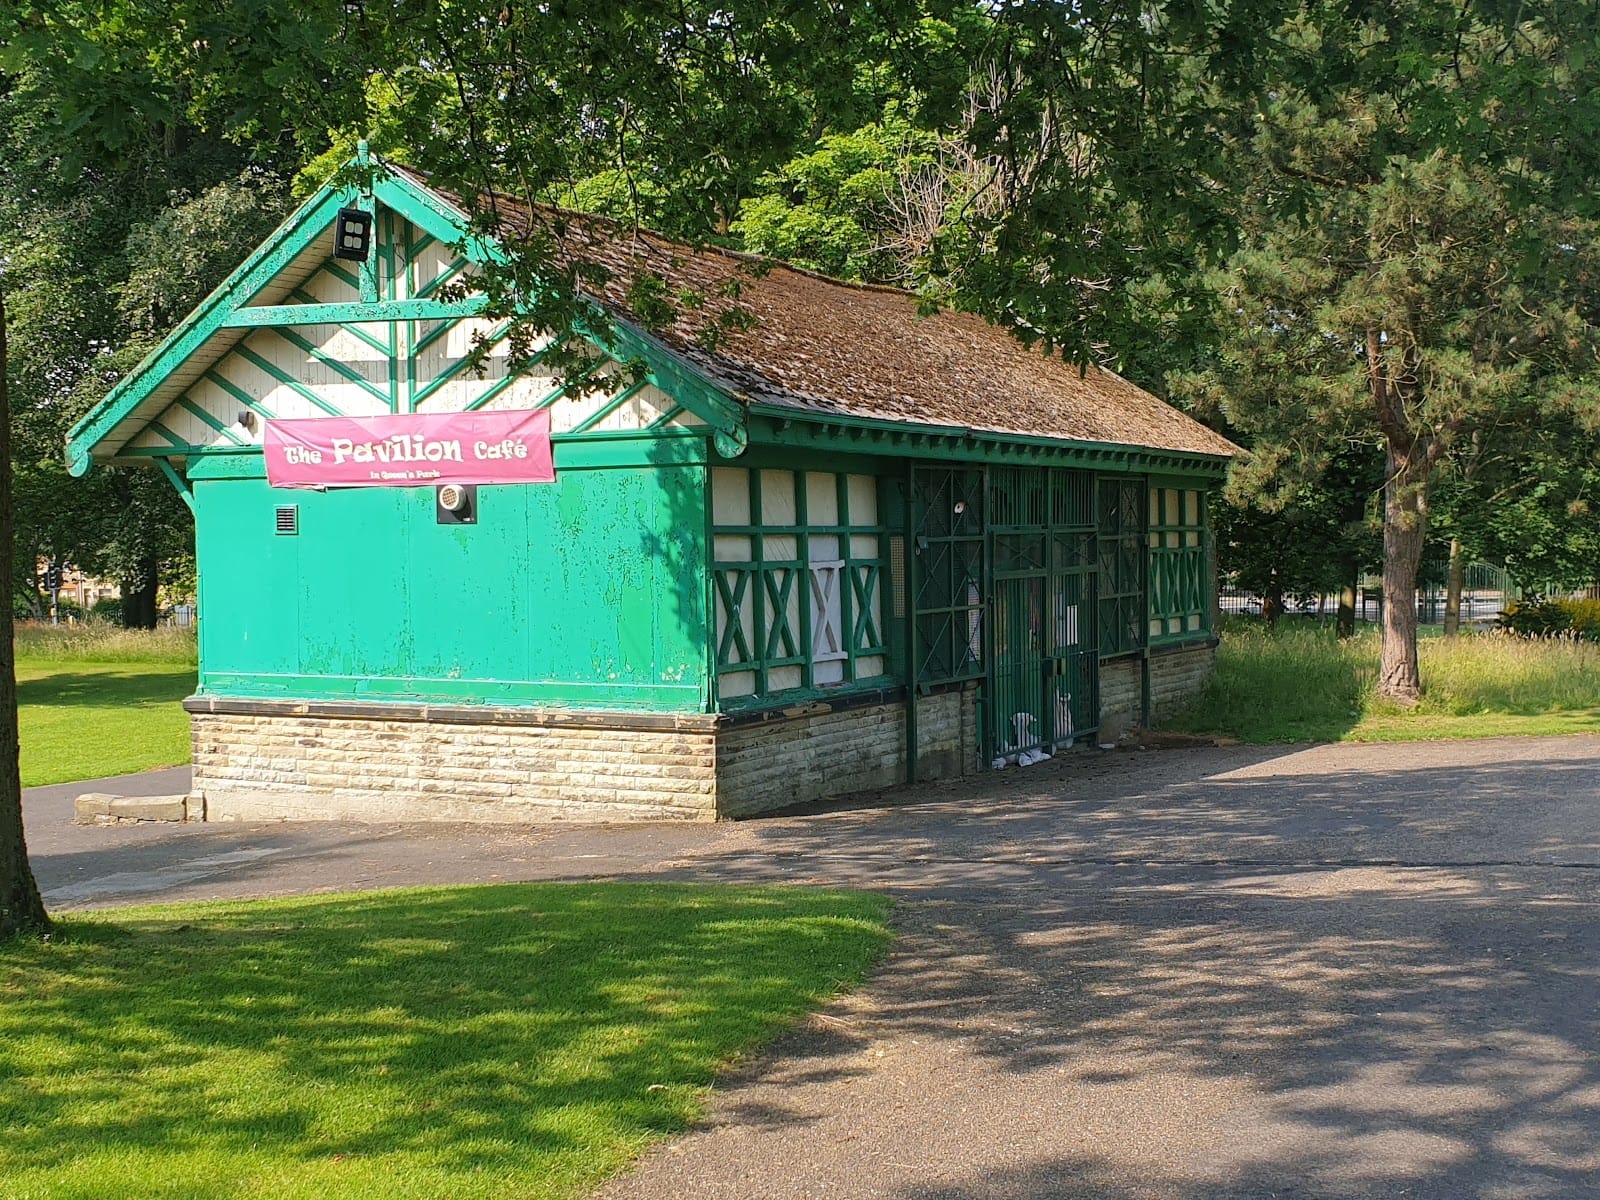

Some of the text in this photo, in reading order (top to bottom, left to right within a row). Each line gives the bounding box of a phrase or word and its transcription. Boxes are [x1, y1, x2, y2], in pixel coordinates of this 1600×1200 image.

[284, 435, 528, 465] The Pavilion Café
[381, 470, 415, 480] Queen's
[416, 470, 441, 478] Park
